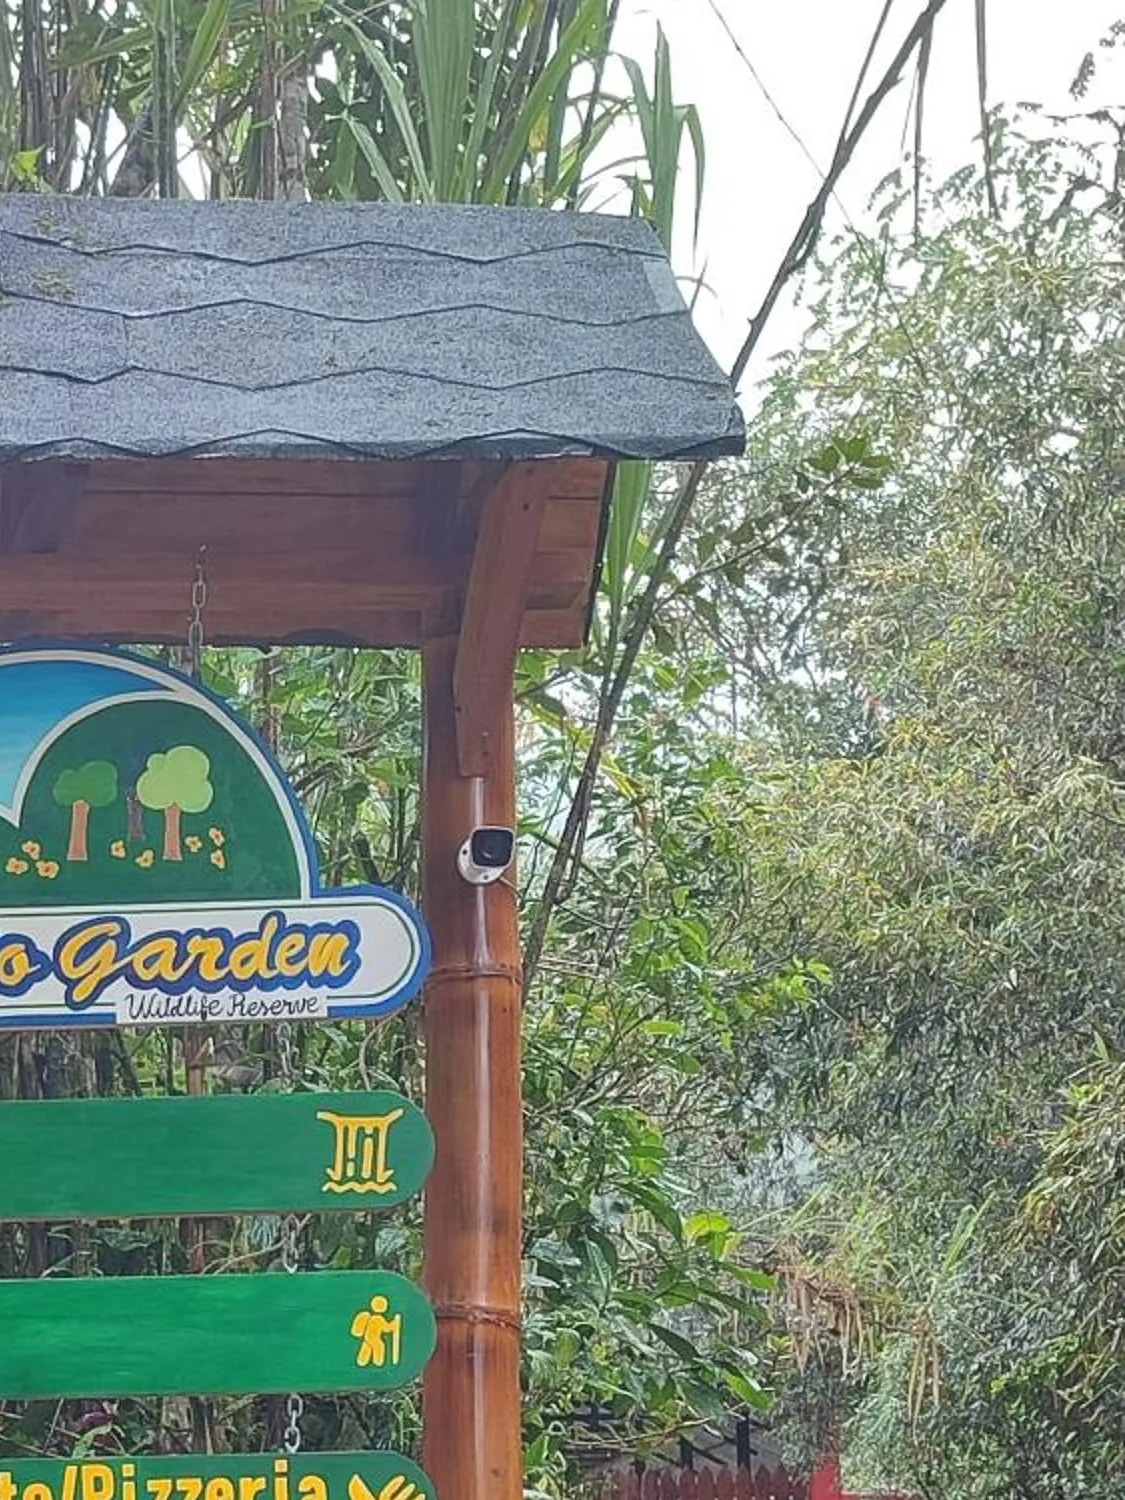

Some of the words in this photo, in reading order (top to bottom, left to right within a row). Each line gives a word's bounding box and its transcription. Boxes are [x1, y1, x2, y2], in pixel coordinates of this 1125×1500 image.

[60, 915, 355, 1006] Garden
[127, 995, 224, 1022] Wildlife
[228, 994, 320, 1017] Reserve
